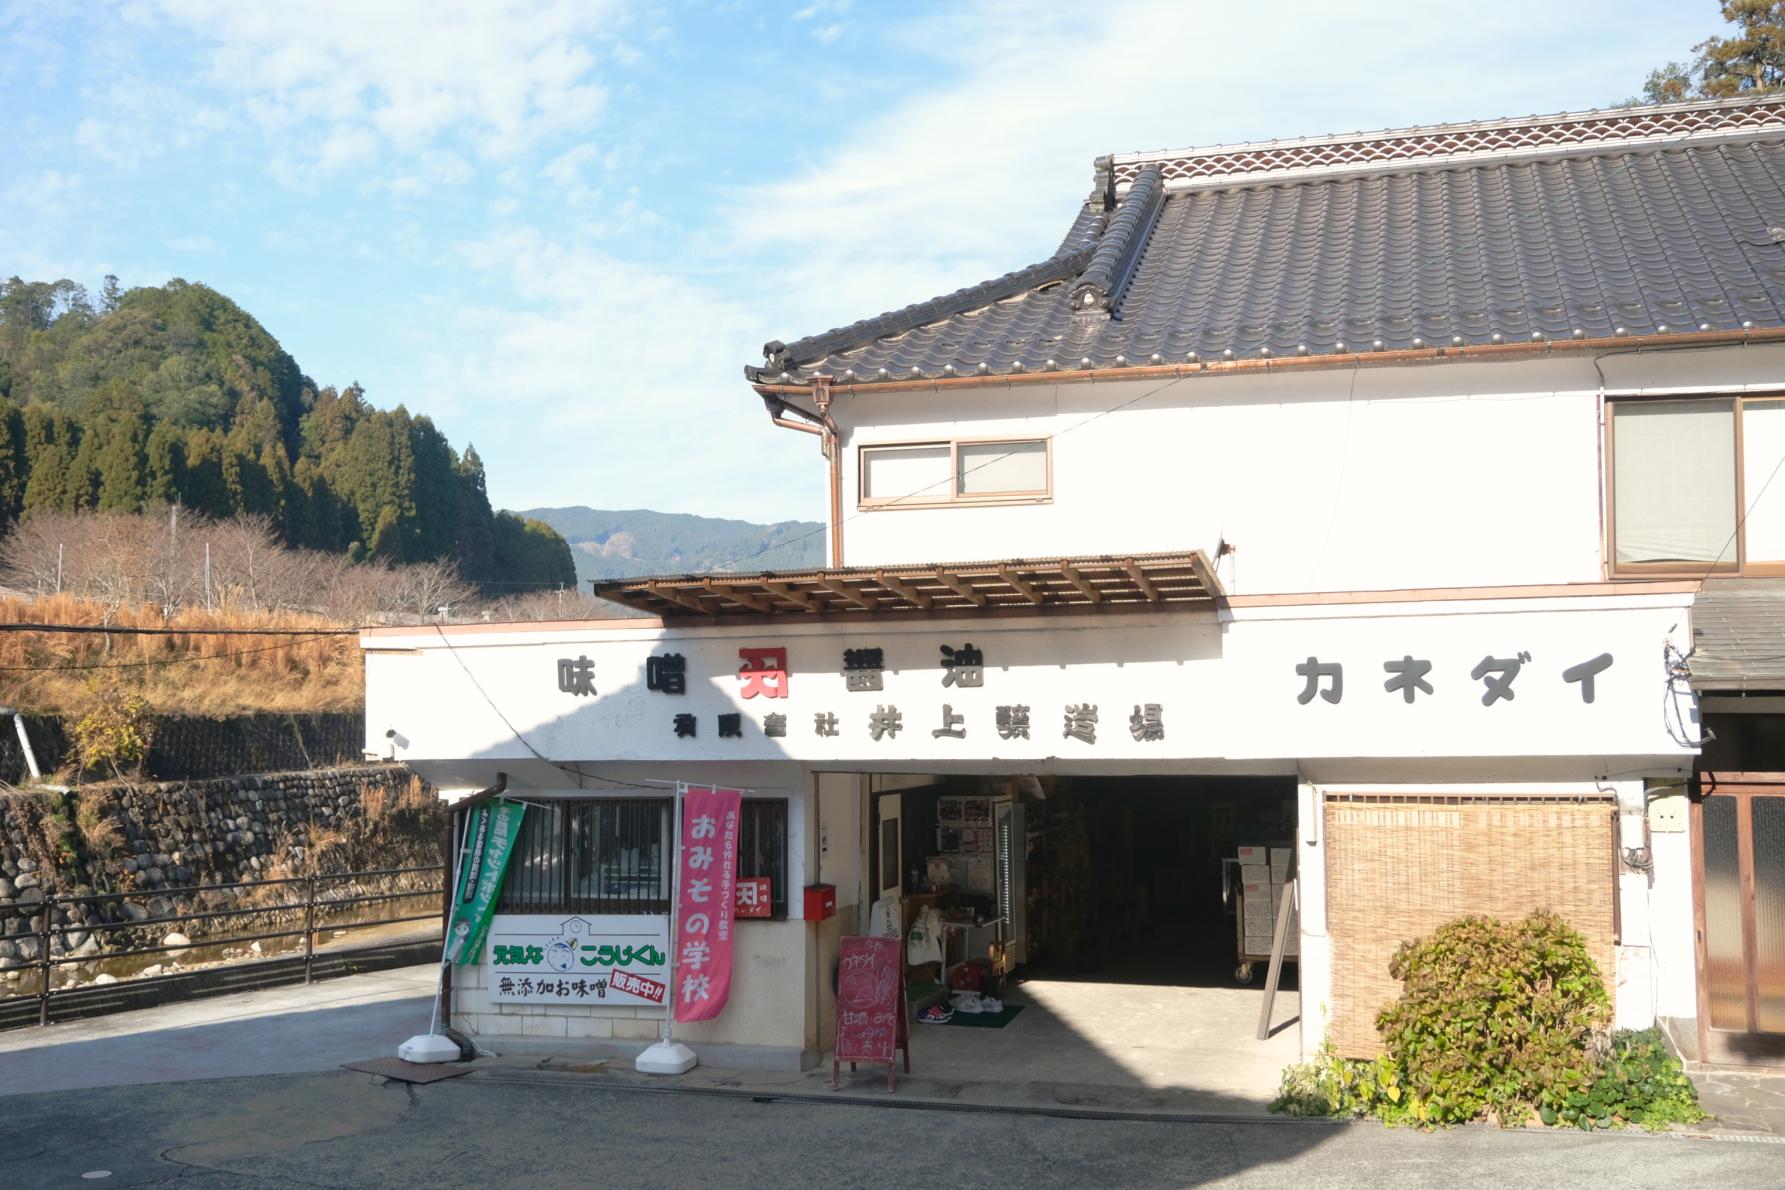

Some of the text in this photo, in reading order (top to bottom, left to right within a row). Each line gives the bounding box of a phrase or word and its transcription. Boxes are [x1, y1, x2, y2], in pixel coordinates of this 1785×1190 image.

[557, 652, 688, 698] 味噌
[1294, 650, 1614, 707] カネダイ
[681, 814, 717, 1003] おみその学校
[493, 944, 544, 965] 元気な
[580, 944, 666, 966] こうじくん
[499, 976, 608, 998] 無添加お味噌
